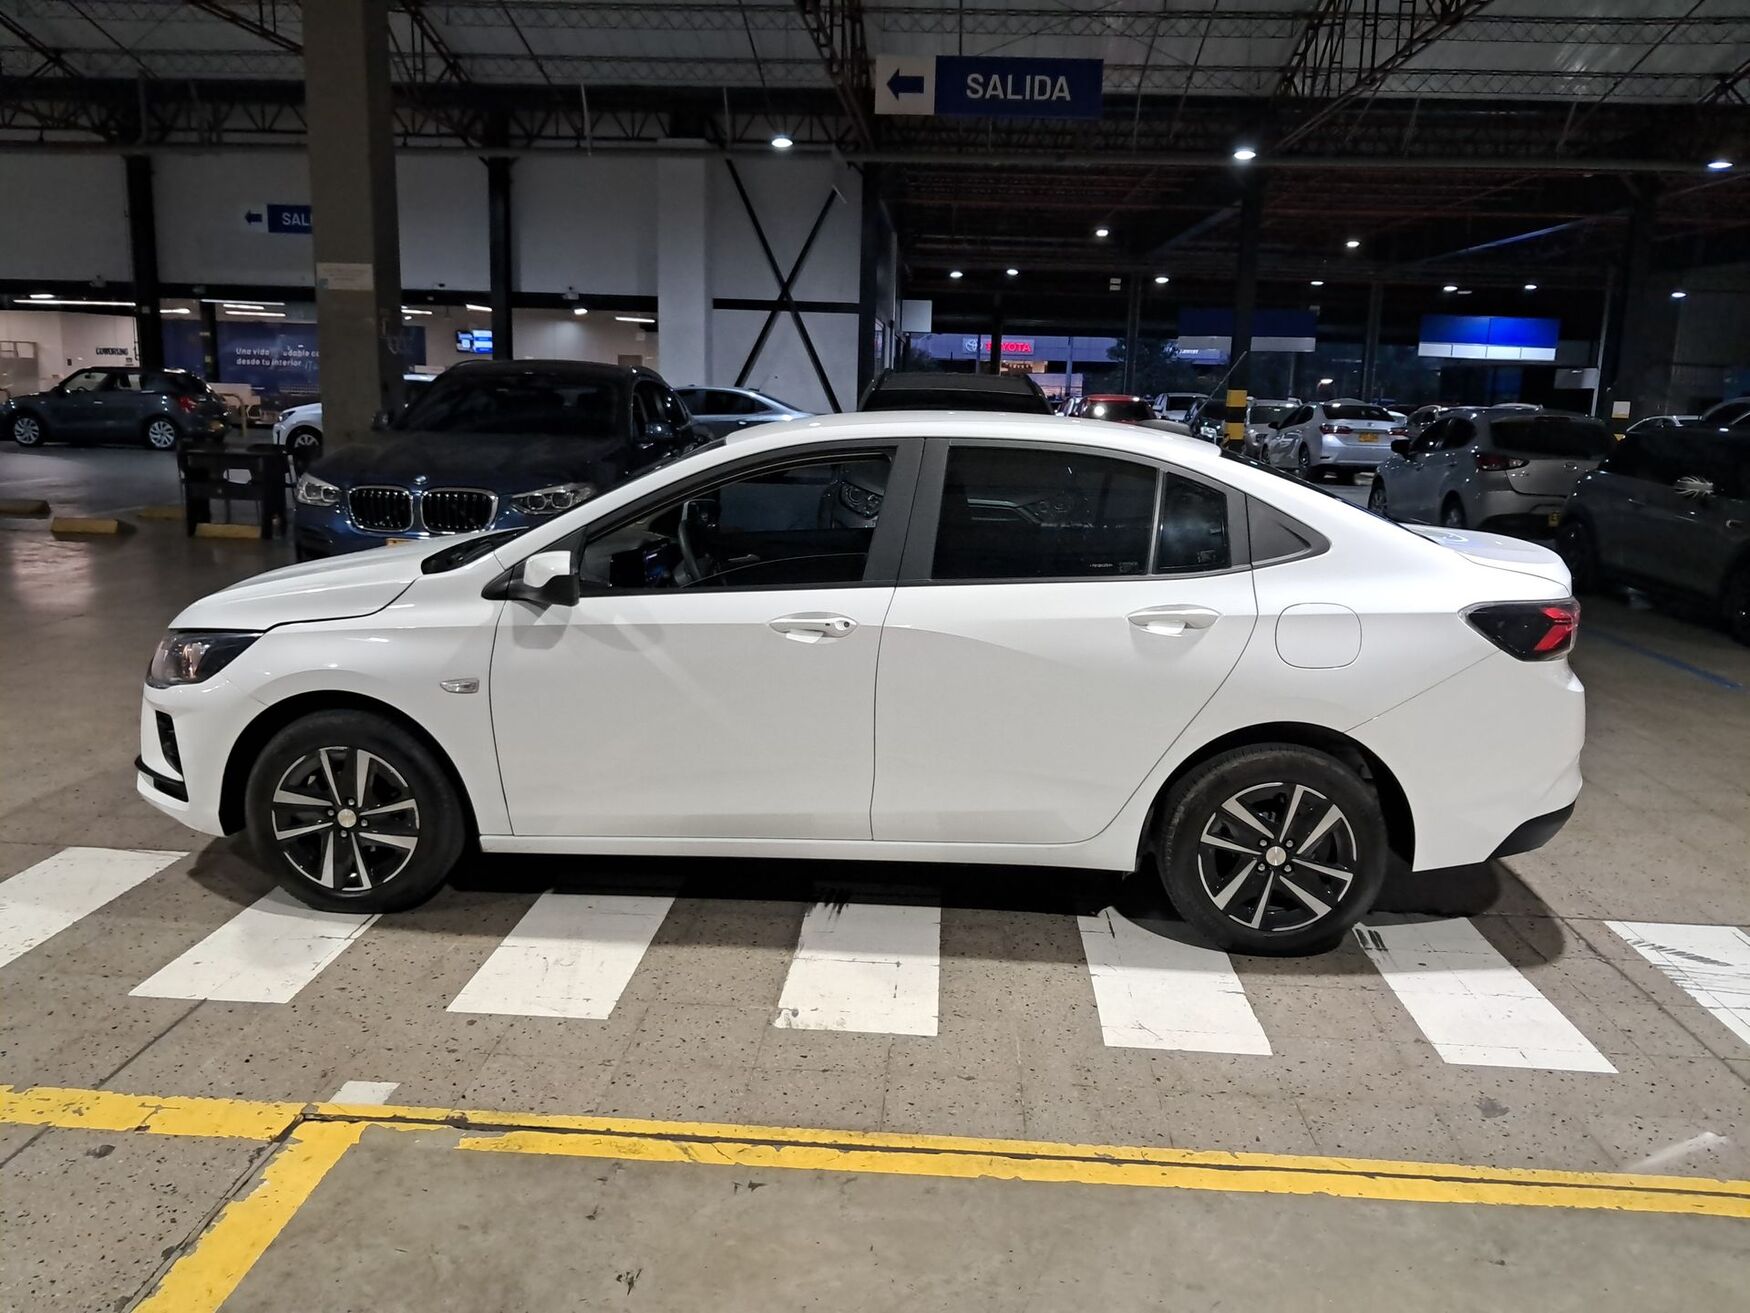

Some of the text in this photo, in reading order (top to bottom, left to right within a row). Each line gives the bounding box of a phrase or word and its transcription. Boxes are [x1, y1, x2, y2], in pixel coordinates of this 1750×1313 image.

[965, 73, 1071, 101] SALIDA
[281, 212, 312, 226] SAL
[984, 341, 1031, 353] TYOTA
